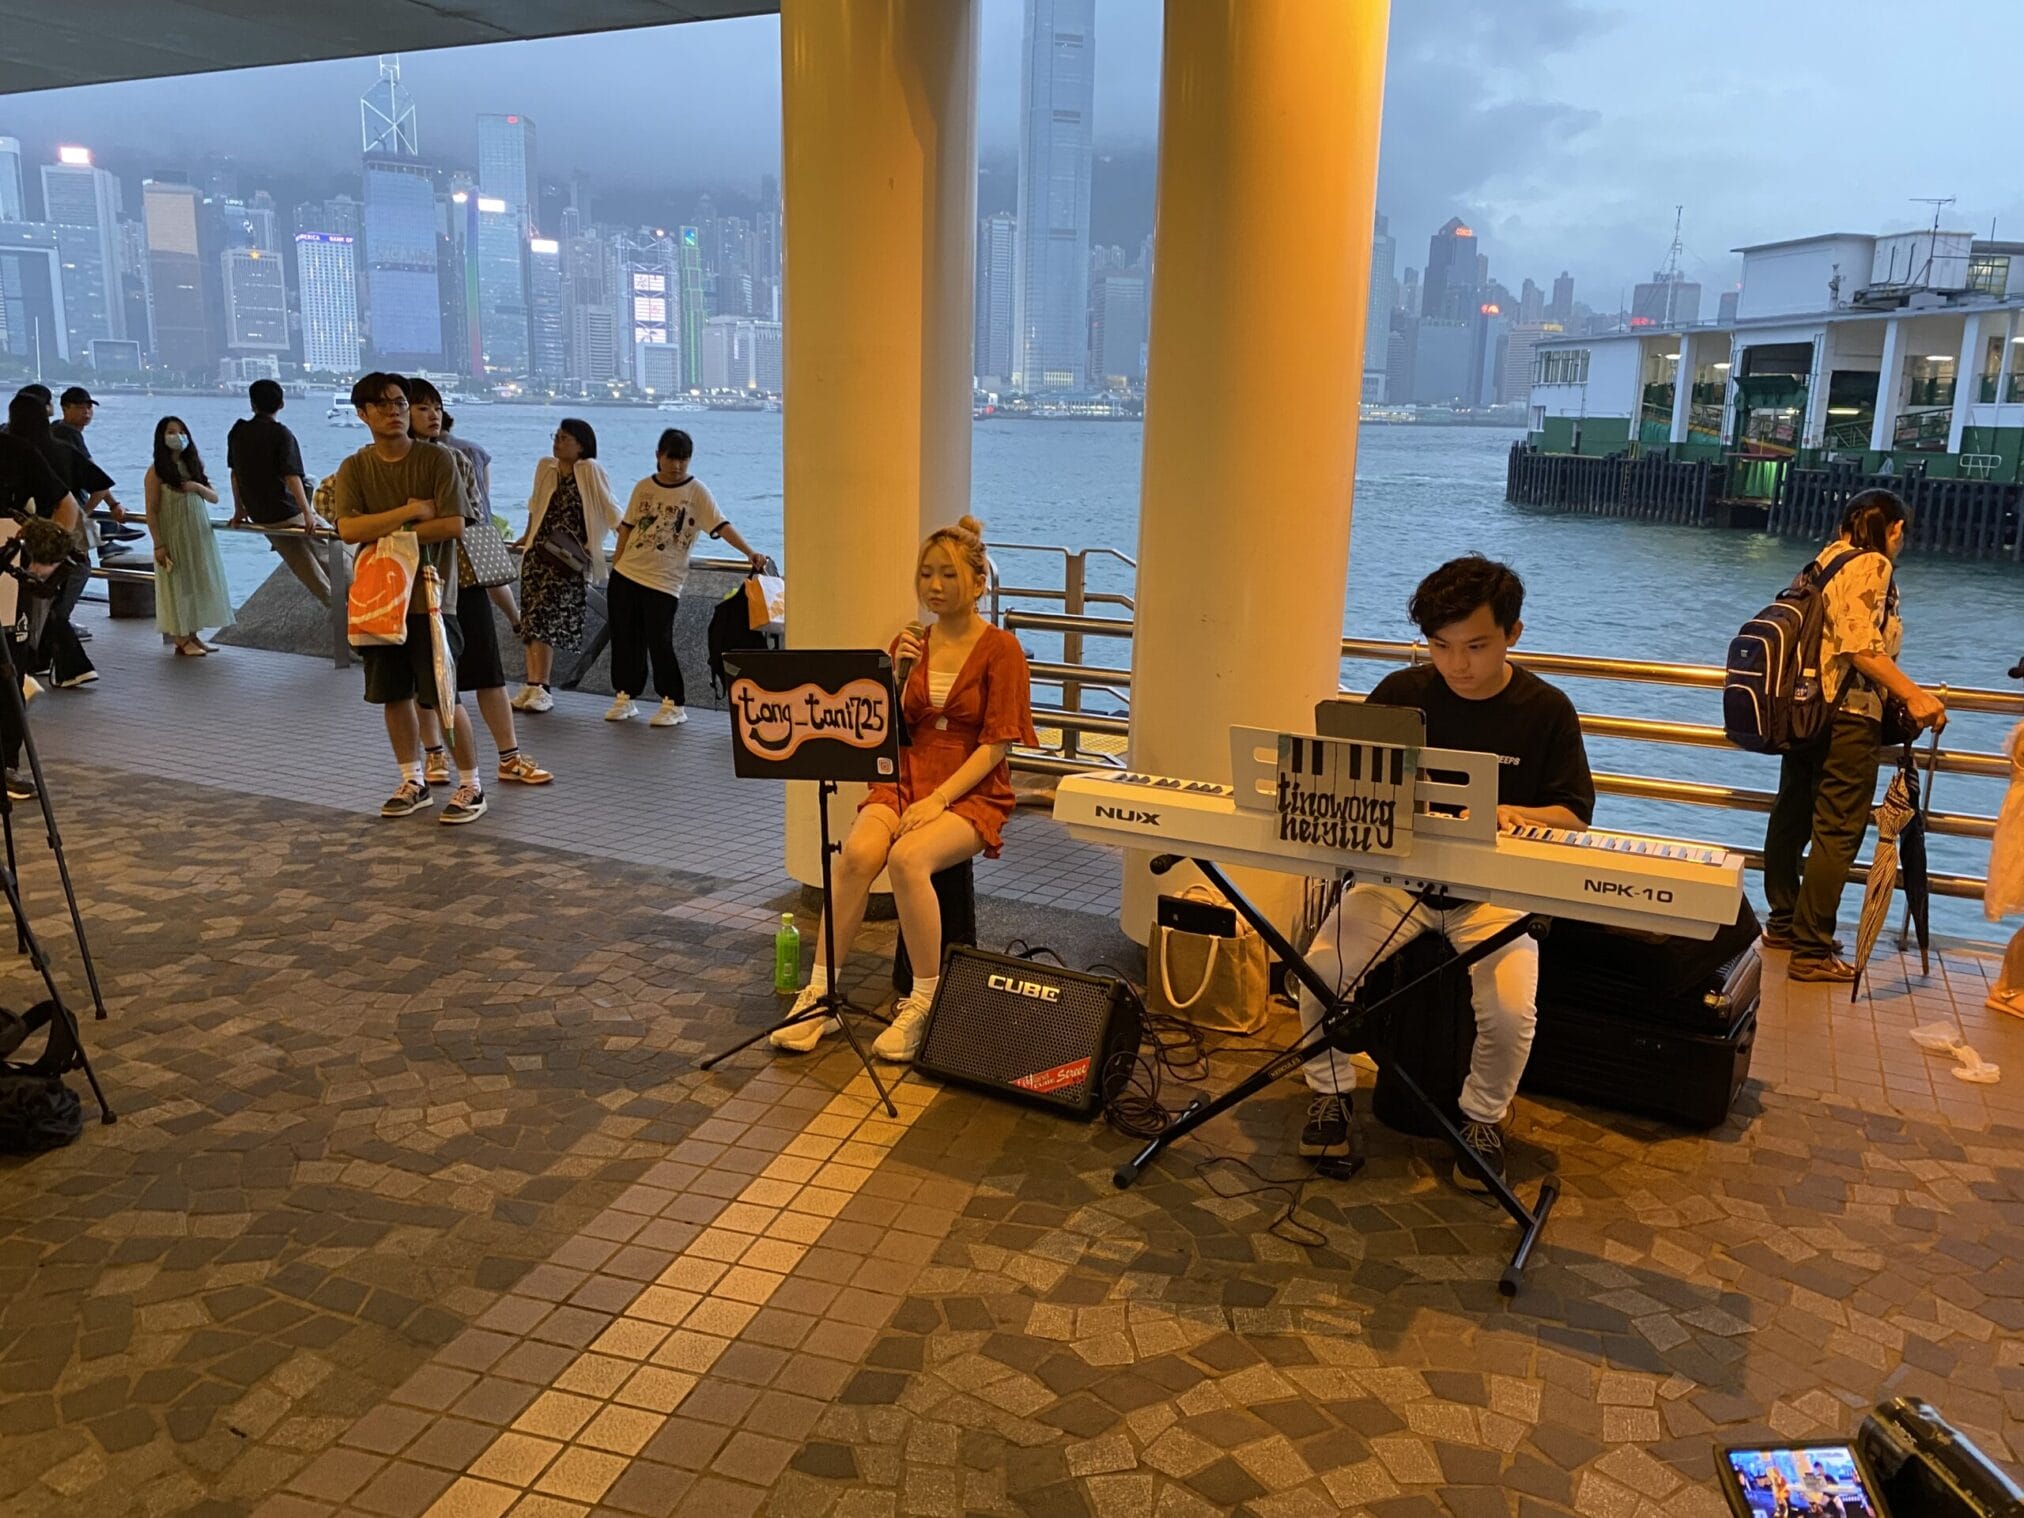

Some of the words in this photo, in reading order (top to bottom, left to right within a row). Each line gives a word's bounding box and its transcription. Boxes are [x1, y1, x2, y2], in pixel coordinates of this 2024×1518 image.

[1499, 755, 1521, 766] EEPS
[1095, 805, 1161, 826] NUX
[1278, 772, 1396, 849] tinowong
[1584, 878, 1674, 904] NPK-10
[987, 974, 1061, 1003] CUBE
